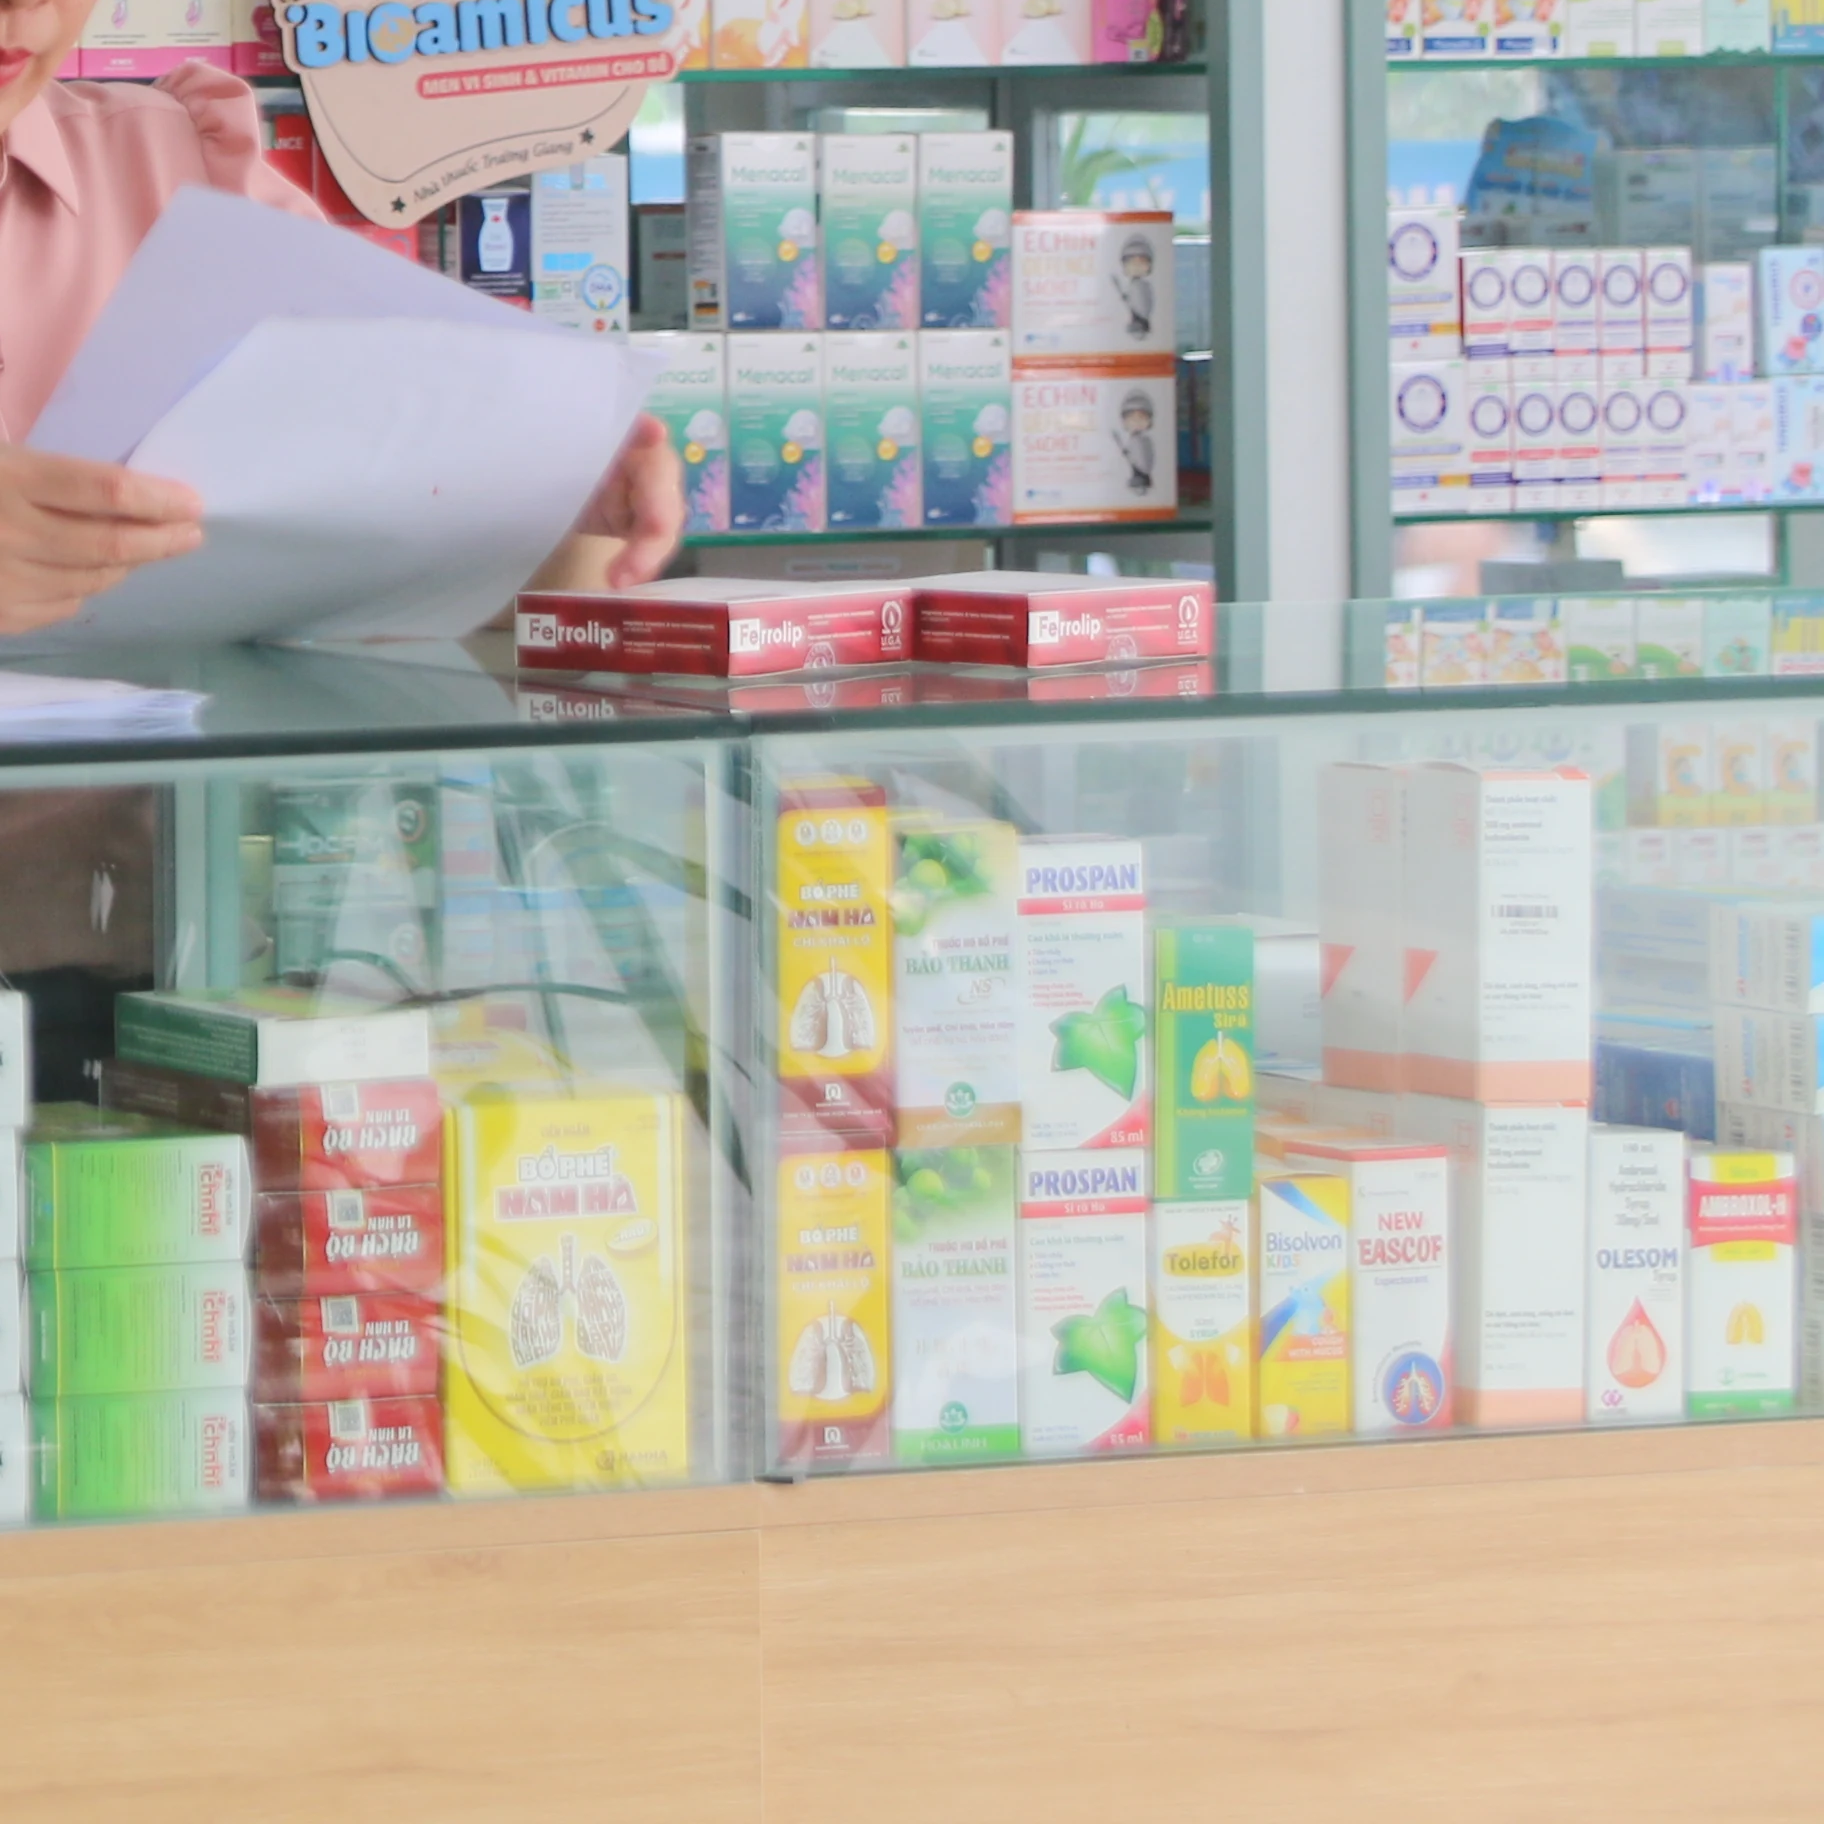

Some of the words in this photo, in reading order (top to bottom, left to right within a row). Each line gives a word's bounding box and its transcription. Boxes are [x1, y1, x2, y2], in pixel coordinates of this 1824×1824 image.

[423, 77, 462, 95] MEN
[463, 75, 481, 91] VI
[483, 72, 523, 90] SINH
[526, 70, 538, 85] &
[541, 63, 610, 84] VITAMIN
[611, 61, 639, 76] CHO
[532, 137, 575, 160] Giang
[528, 621, 614, 650] Ferrolip
[1026, 864, 1136, 895] PROSPAN
[1161, 982, 1249, 1010] Ametuss
[1109, 1129, 1125, 1143] 85
[1127, 1128, 1143, 1143] ml
[499, 1184, 580, 1219] NAM
[1377, 1212, 1423, 1230] NEW
[1266, 1230, 1342, 1252] Bisolvon
[1358, 1236, 1443, 1265] EASCOF
[1167, 1251, 1240, 1272] Tolefor
[1266, 1254, 1301, 1269] KIDS
[1596, 1247, 1679, 1268] OLESOM
